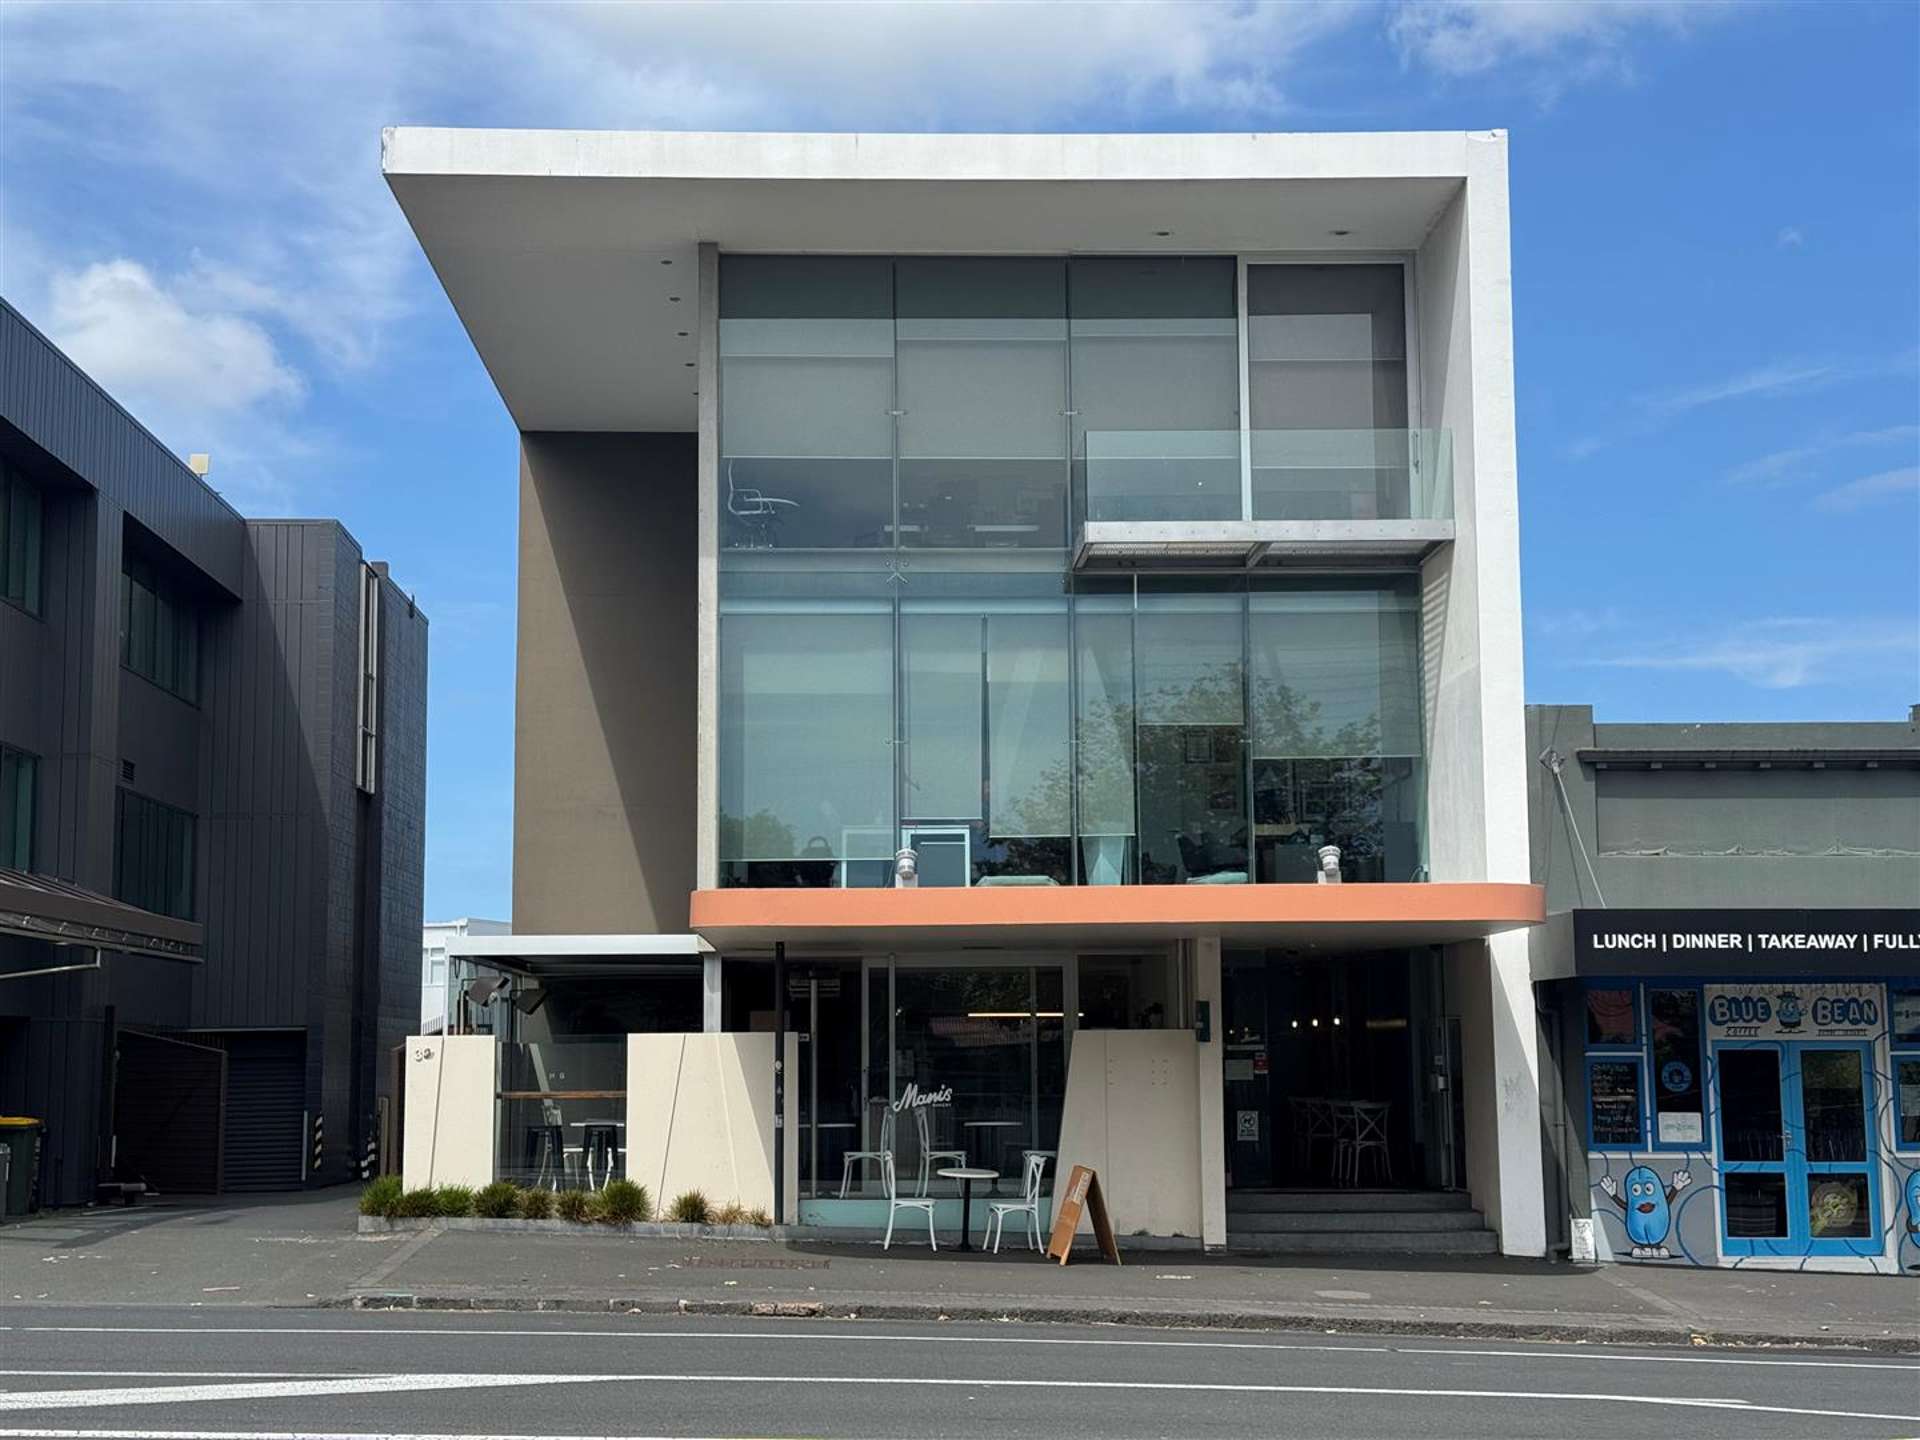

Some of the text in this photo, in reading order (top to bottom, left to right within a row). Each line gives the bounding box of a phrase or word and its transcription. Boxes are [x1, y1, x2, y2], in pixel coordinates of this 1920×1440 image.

[1593, 934, 1656, 949] LUNCH
[1672, 933, 1743, 949] DINNER
[1757, 934, 1858, 949] TAKEAWAY
[1873, 934, 1920, 949] FULL
[1712, 997, 1876, 1024] BLUE BEAN
